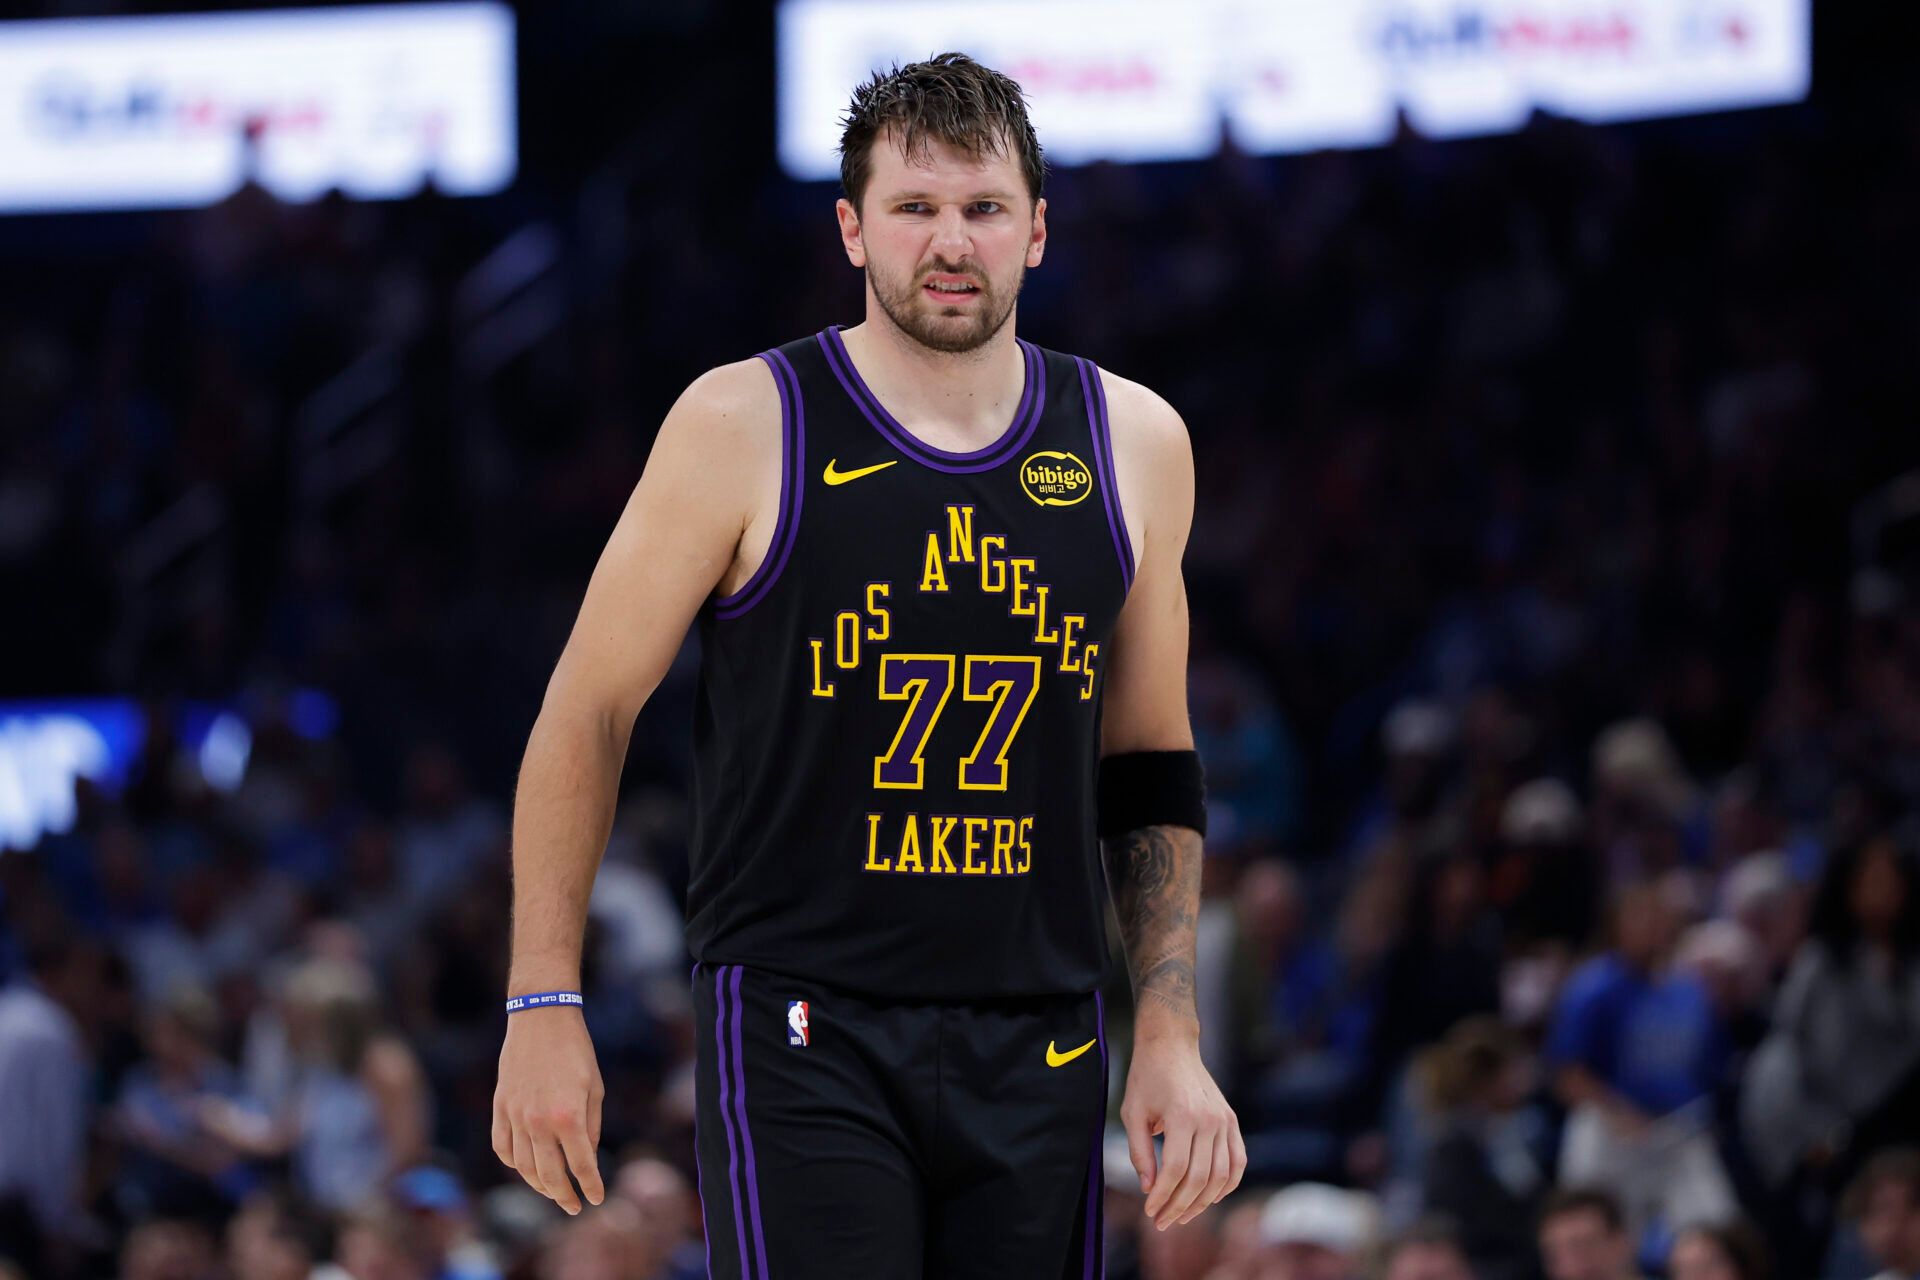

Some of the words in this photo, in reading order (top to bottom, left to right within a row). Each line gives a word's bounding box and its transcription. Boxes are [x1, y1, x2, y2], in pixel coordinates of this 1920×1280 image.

[1026, 465, 1087, 490] bibigo
[1039, 485, 1065, 494] 비비고
[809, 582, 891, 698] LOS
[918, 504, 1099, 701] ANGELES
[874, 654, 1042, 791] 77
[863, 812, 1035, 876] LAKERS
